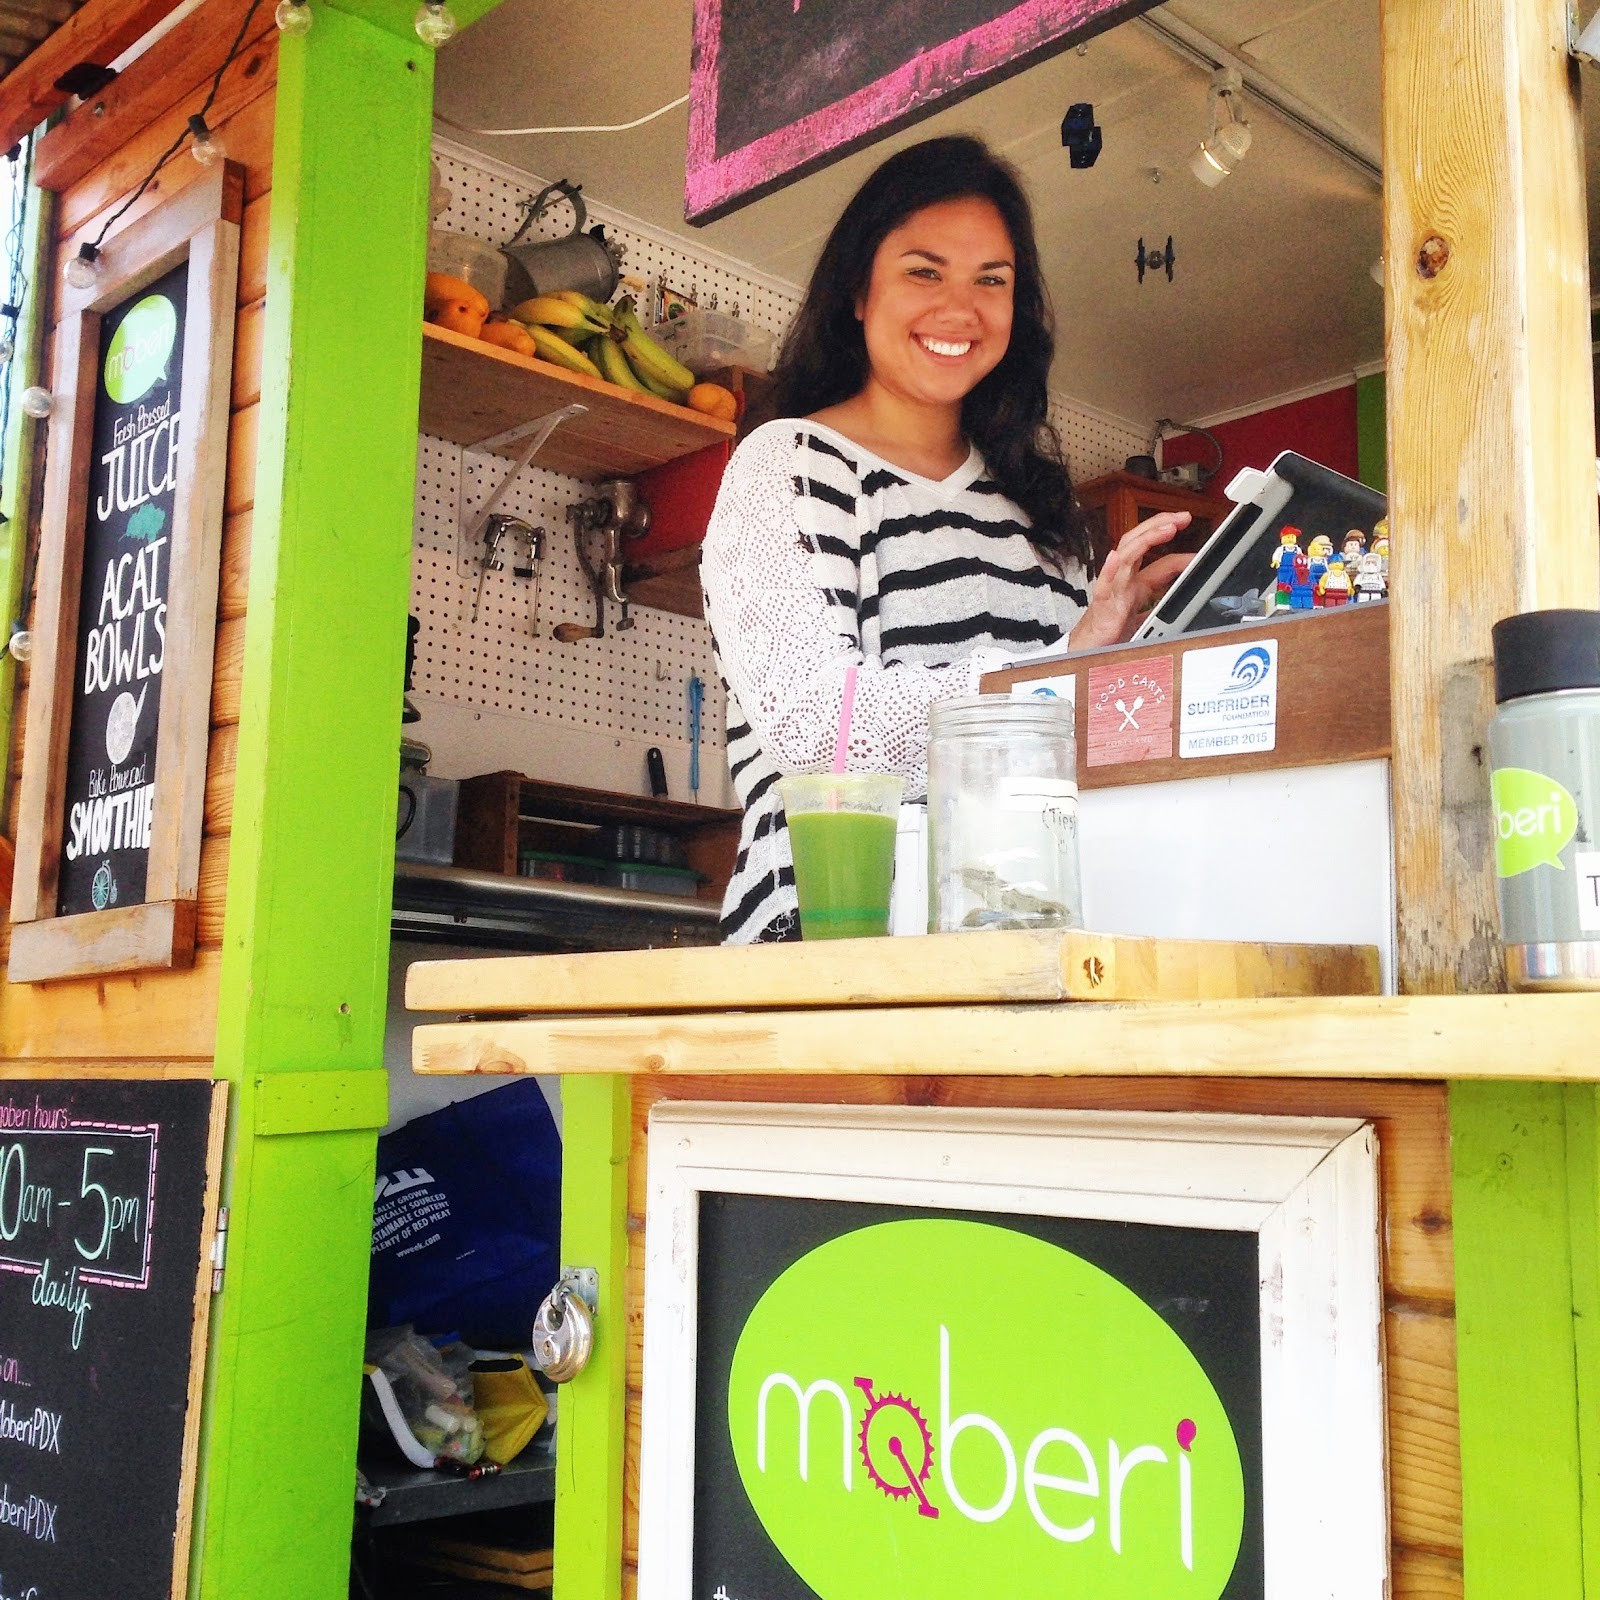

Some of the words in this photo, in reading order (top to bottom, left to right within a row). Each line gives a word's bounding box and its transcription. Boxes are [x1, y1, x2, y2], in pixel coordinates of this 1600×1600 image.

[97, 411, 180, 521] JUICE
[98, 537, 167, 626] ACAI
[84, 603, 168, 696] BOWLS
[1095, 678, 1126, 711] FOOD
[1132, 674, 1166, 704] CARTS
[1187, 695, 1270, 716] SURFRIDER
[1222, 710, 1270, 722] FOUNDATION
[1188, 735, 1239, 750] MEMBER
[1241, 731, 1268, 745] 2015
[397, 1188, 428, 1205] GROWN
[409, 1192, 446, 1210] SOURCED
[413, 1200, 450, 1218] CONTENT
[371, 1233, 400, 1255] PLENTY
[401, 1227, 413, 1239] OF
[411, 1217, 429, 1232] RED
[429, 1208, 452, 1224] MEAT
[32, 1258, 91, 1350] daily
[756, 1323, 1198, 1572] moberi
